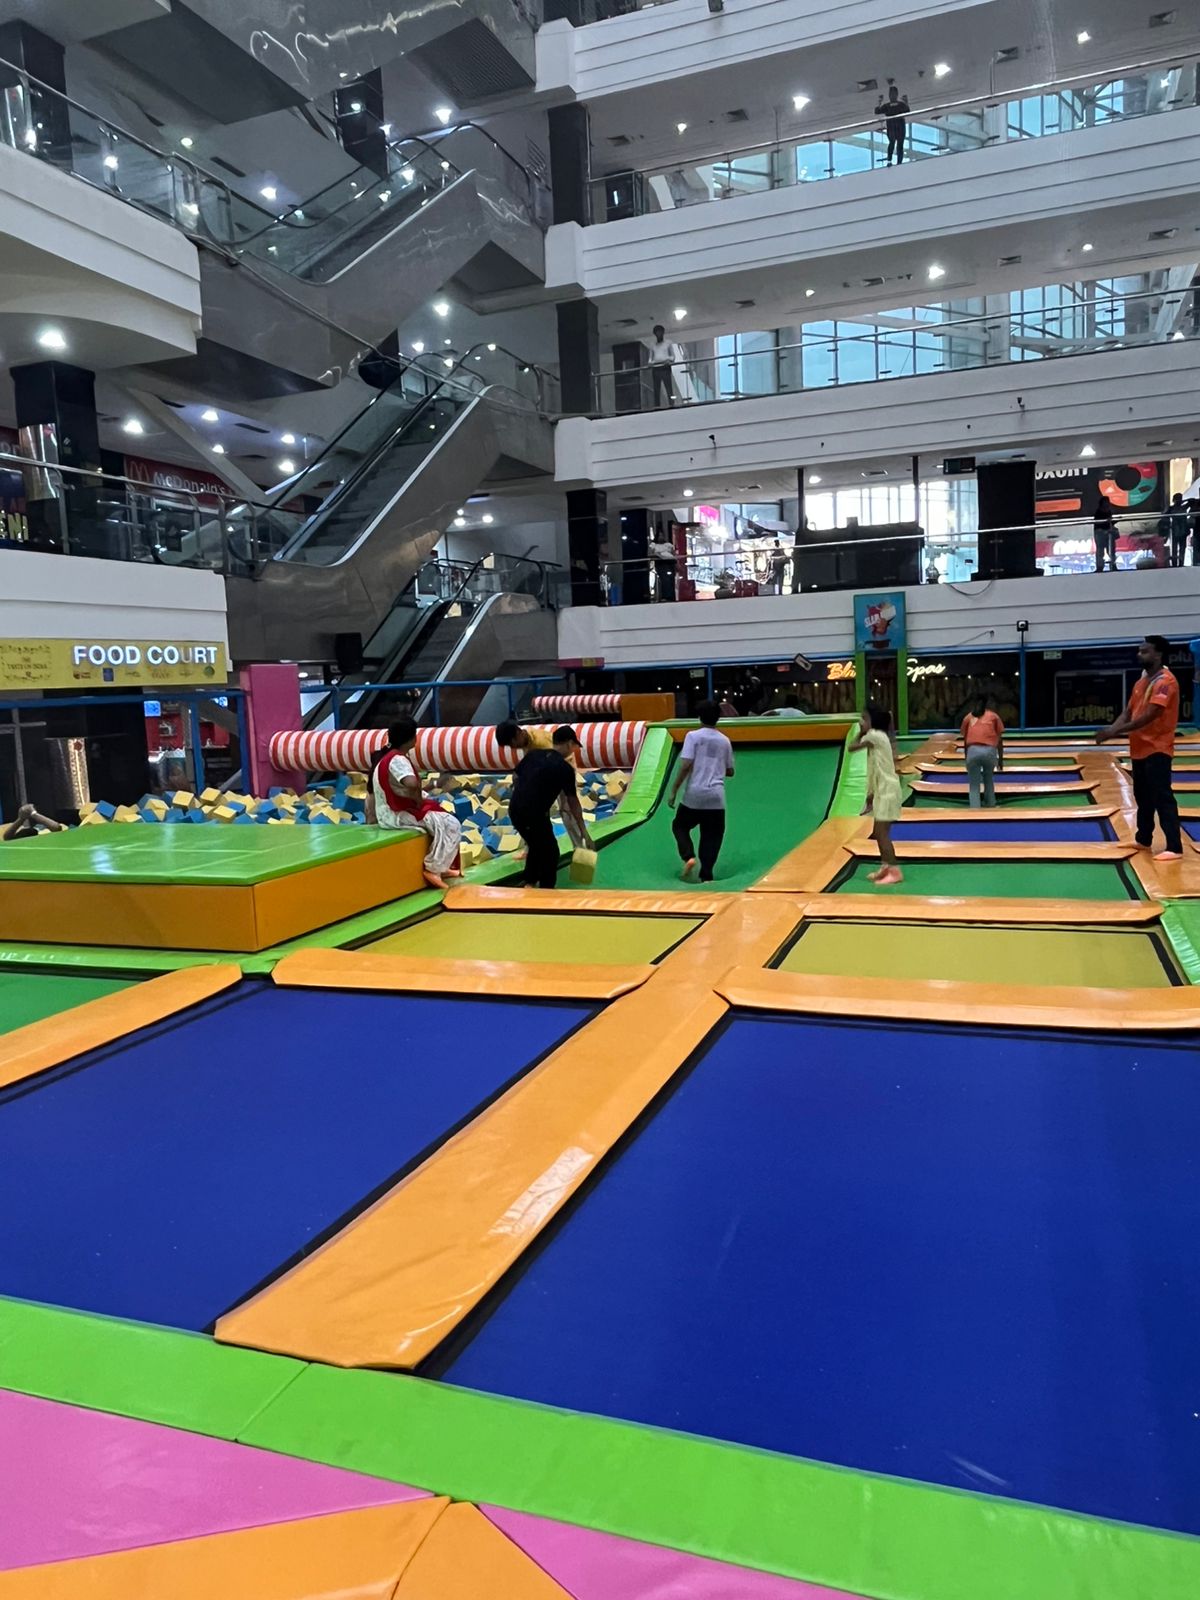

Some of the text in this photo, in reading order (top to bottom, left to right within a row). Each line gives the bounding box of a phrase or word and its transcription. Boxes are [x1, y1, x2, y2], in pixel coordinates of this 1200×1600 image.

[153, 471, 225, 494] McDonald's
[73, 645, 217, 665] FOOD COURT
[1063, 703, 1115, 723] OPENING
